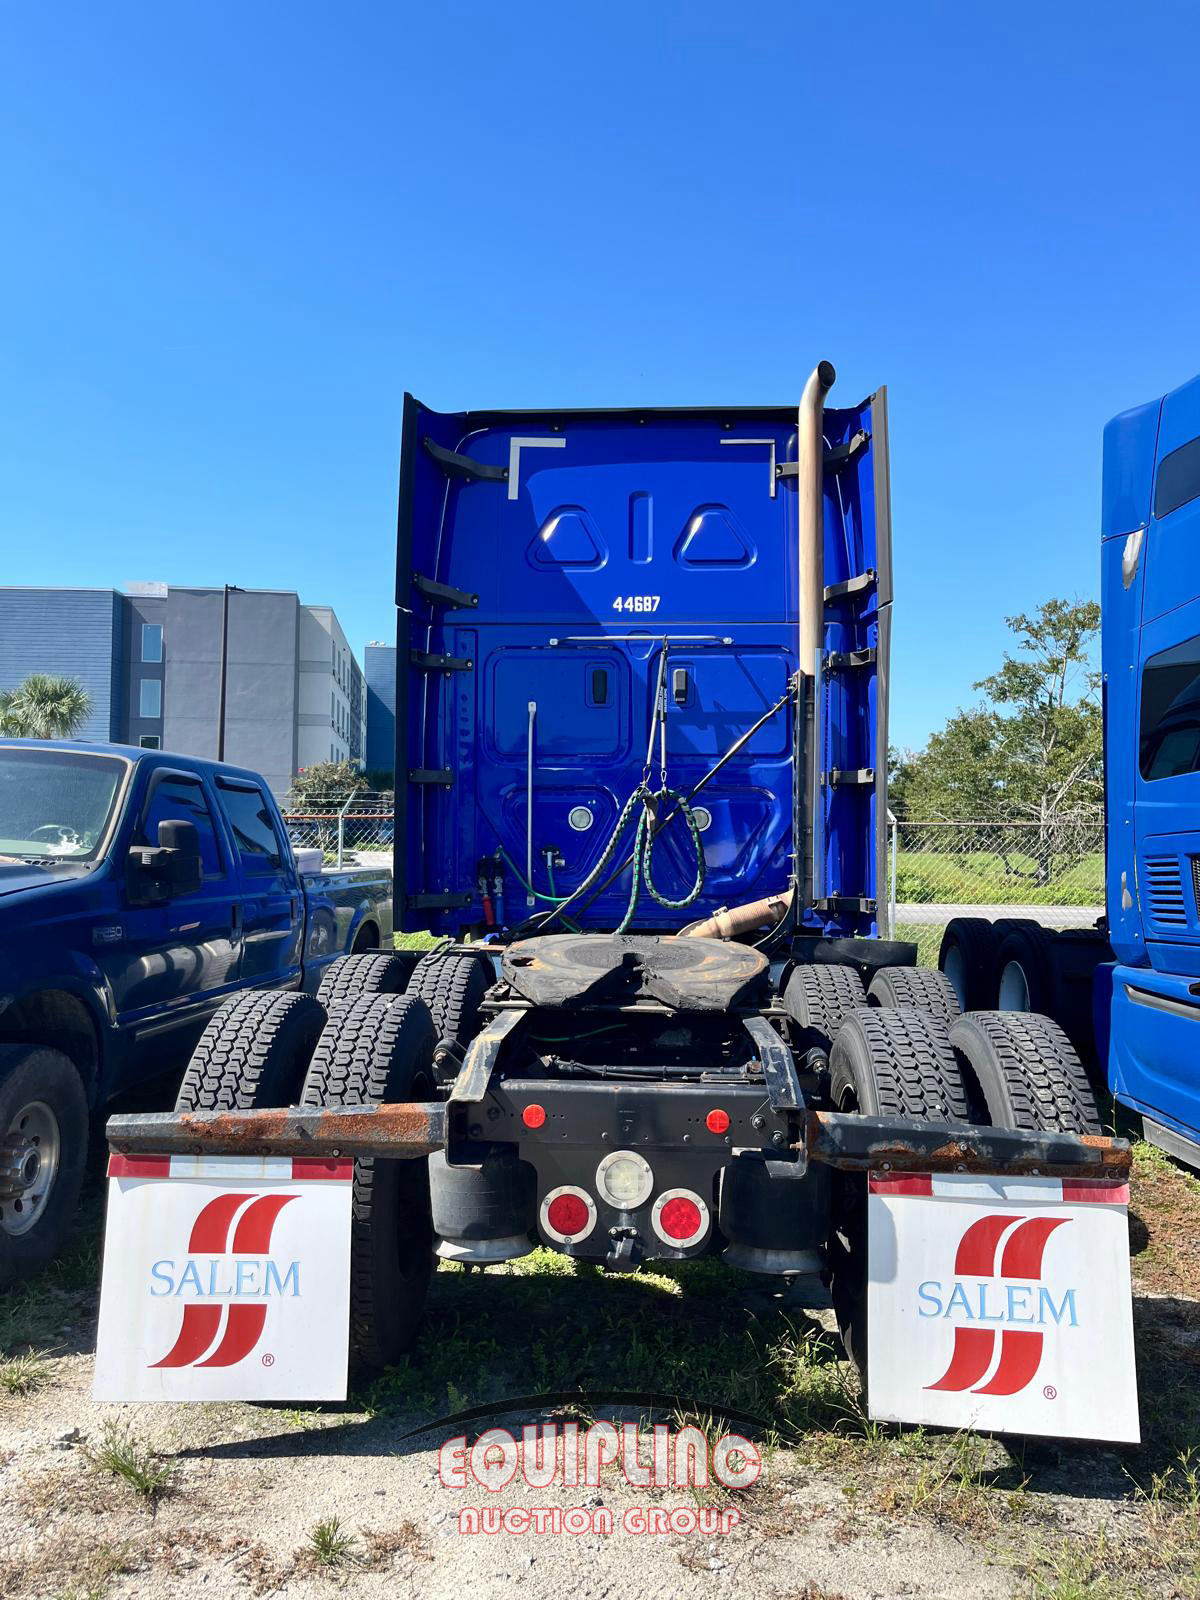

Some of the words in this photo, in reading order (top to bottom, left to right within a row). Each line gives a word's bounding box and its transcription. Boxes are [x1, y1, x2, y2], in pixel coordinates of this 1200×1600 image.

[612, 595, 661, 612] 44687
[150, 1259, 302, 1297] SALEM
[918, 1281, 1080, 1327] SALEM
